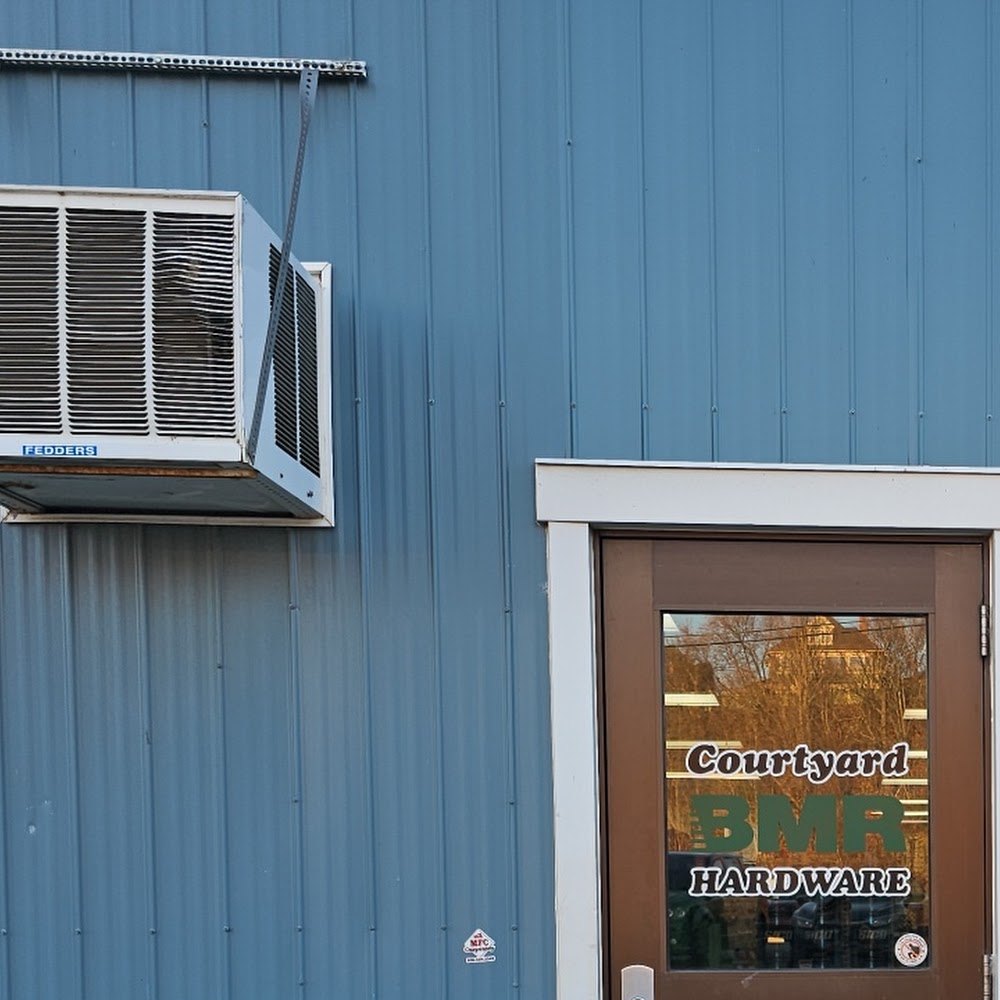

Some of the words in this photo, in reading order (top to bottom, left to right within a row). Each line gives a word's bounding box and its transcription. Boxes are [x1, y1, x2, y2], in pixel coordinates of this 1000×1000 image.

[24, 446, 95, 456] FEDDERS
[686, 742, 908, 784] Courtyard
[690, 794, 907, 852] BMR
[688, 866, 911, 897] HARDWARE
